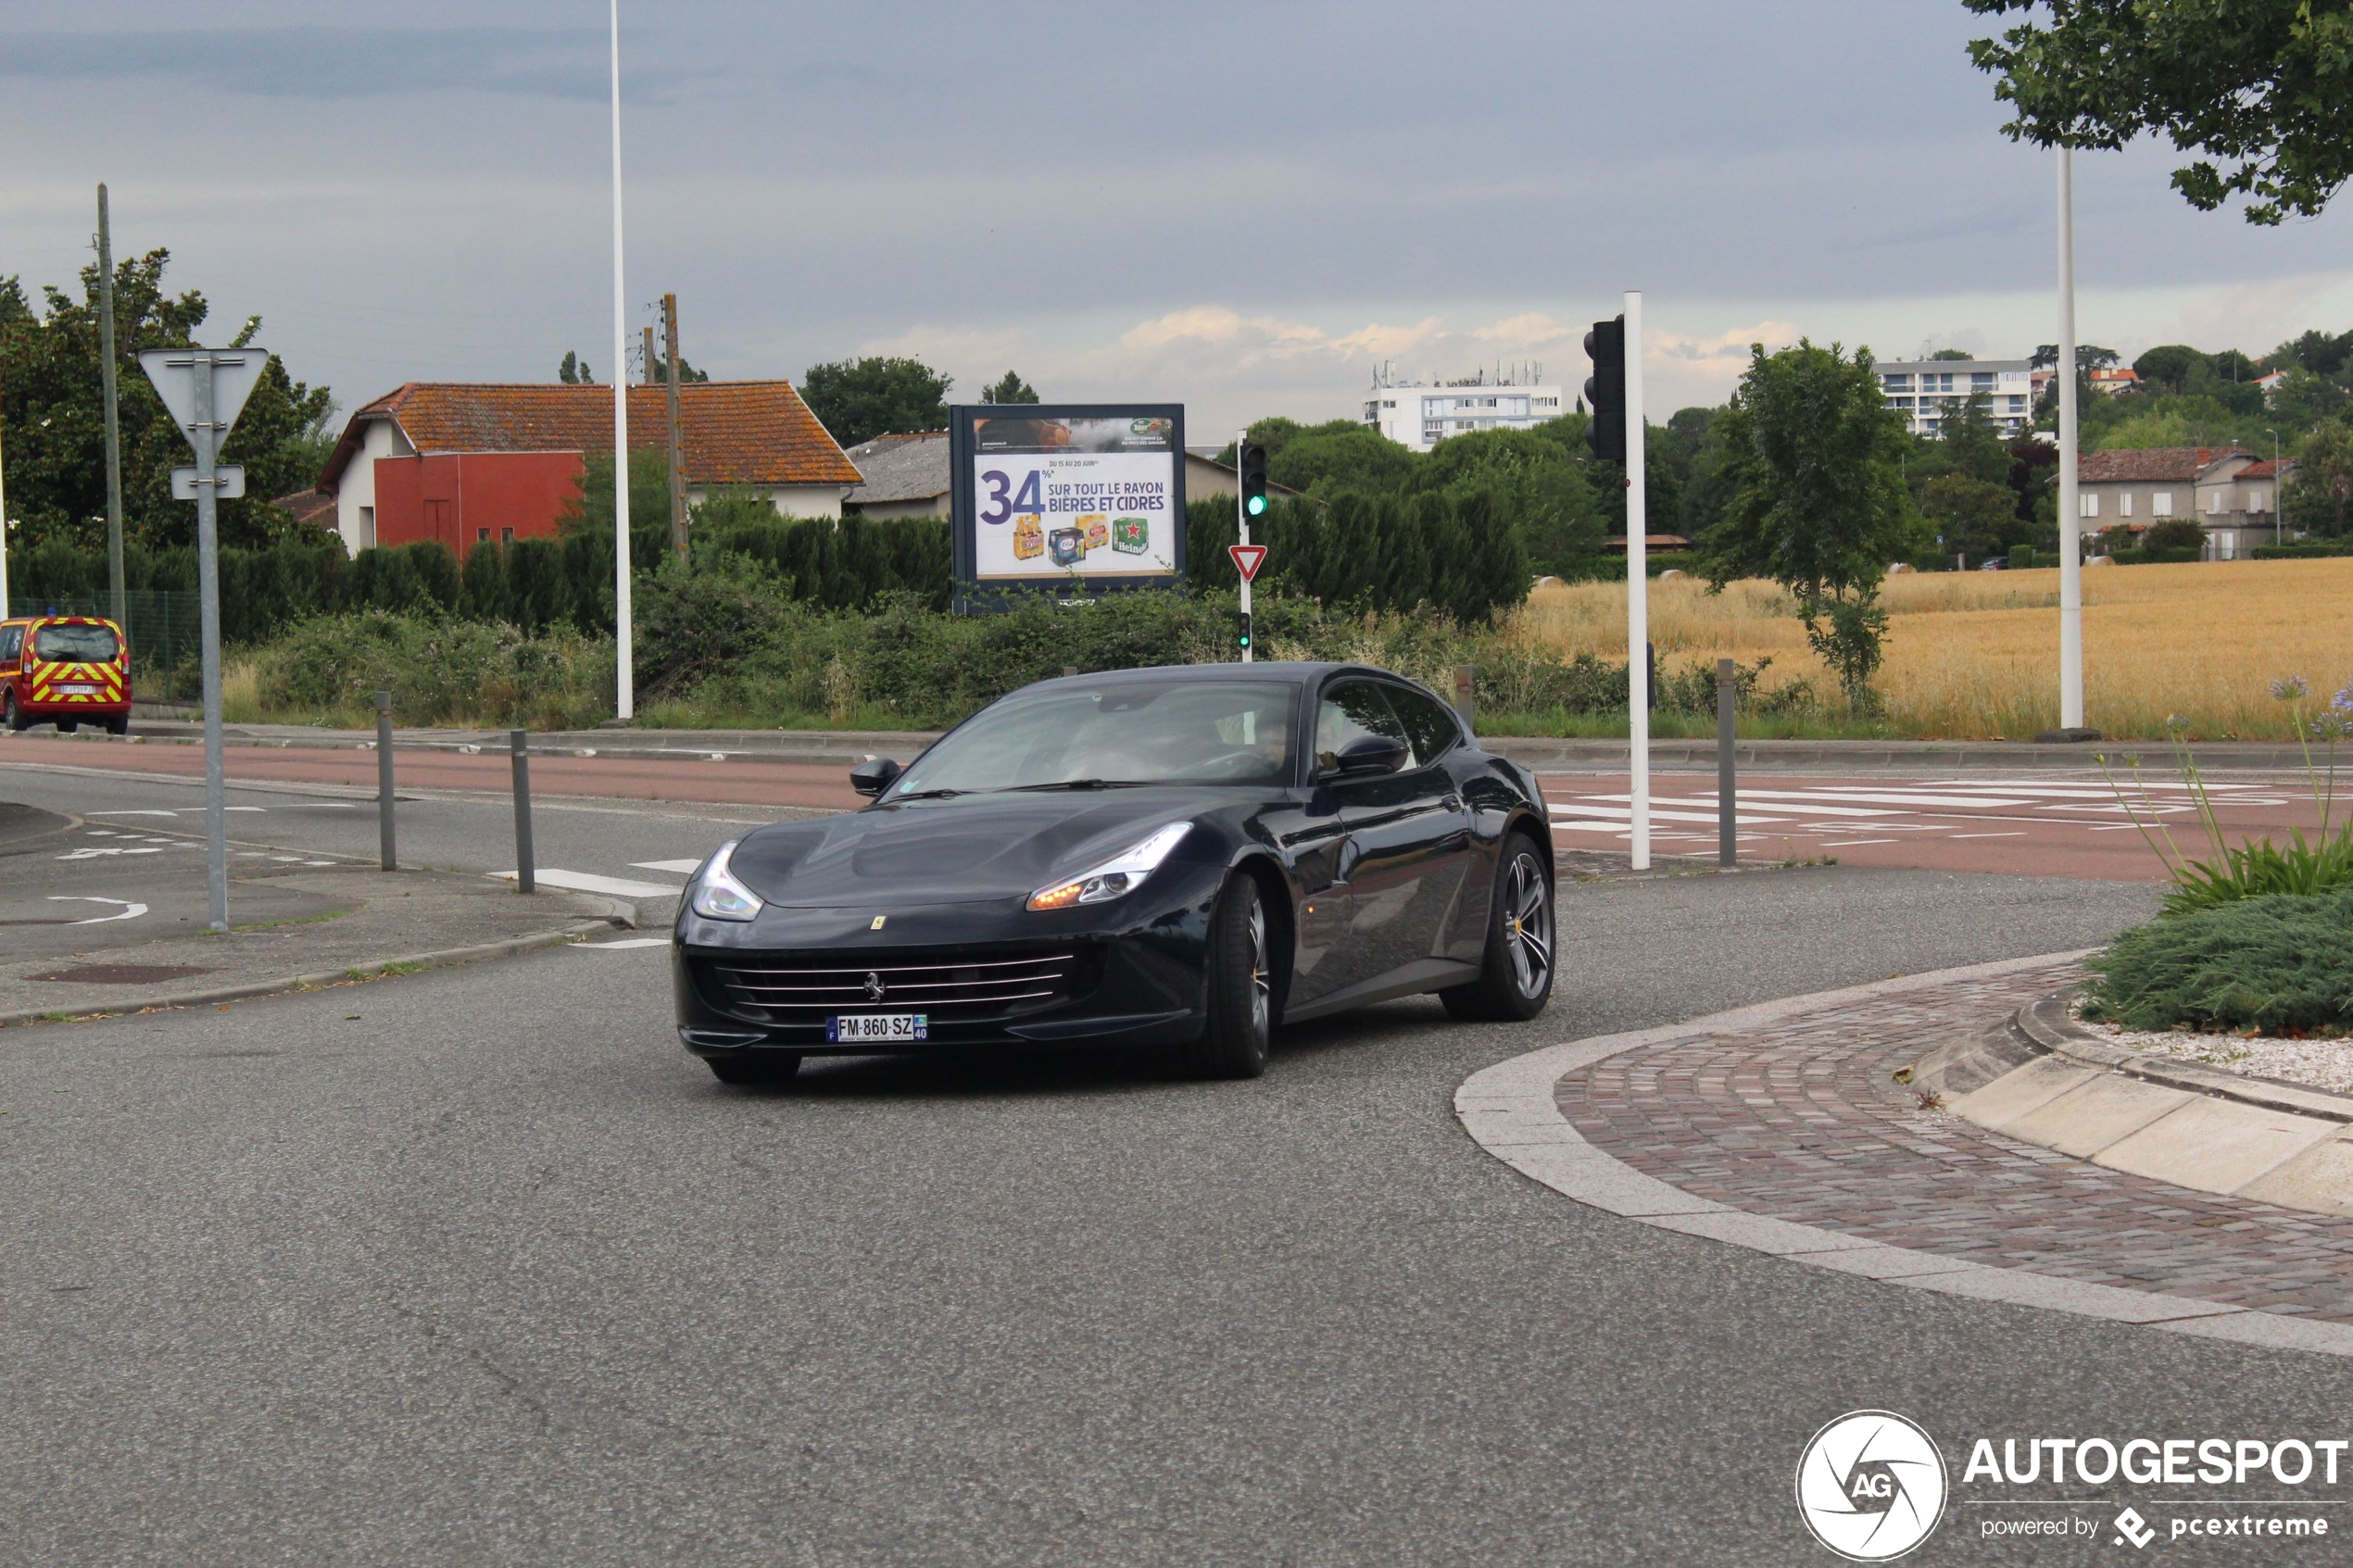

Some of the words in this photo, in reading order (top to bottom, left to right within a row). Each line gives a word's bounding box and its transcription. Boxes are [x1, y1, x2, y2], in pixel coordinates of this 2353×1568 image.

[1049, 483, 1070, 495] SUR
[1075, 483, 1103, 495] TOUT
[1108, 483, 1120, 494] LE
[1124, 482, 1164, 494] RAYON
[979, 470, 1046, 525] 34
[1049, 495, 1095, 512] BIÈRES
[1100, 497, 1114, 511] ET
[1117, 495, 1164, 511] CIDRES
[2033, 792, 2353, 814] BUS
[838, 1018, 912, 1036] FM-860-SZ
[914, 1028, 926, 1039] 40
[829, 1032, 835, 1040] F
